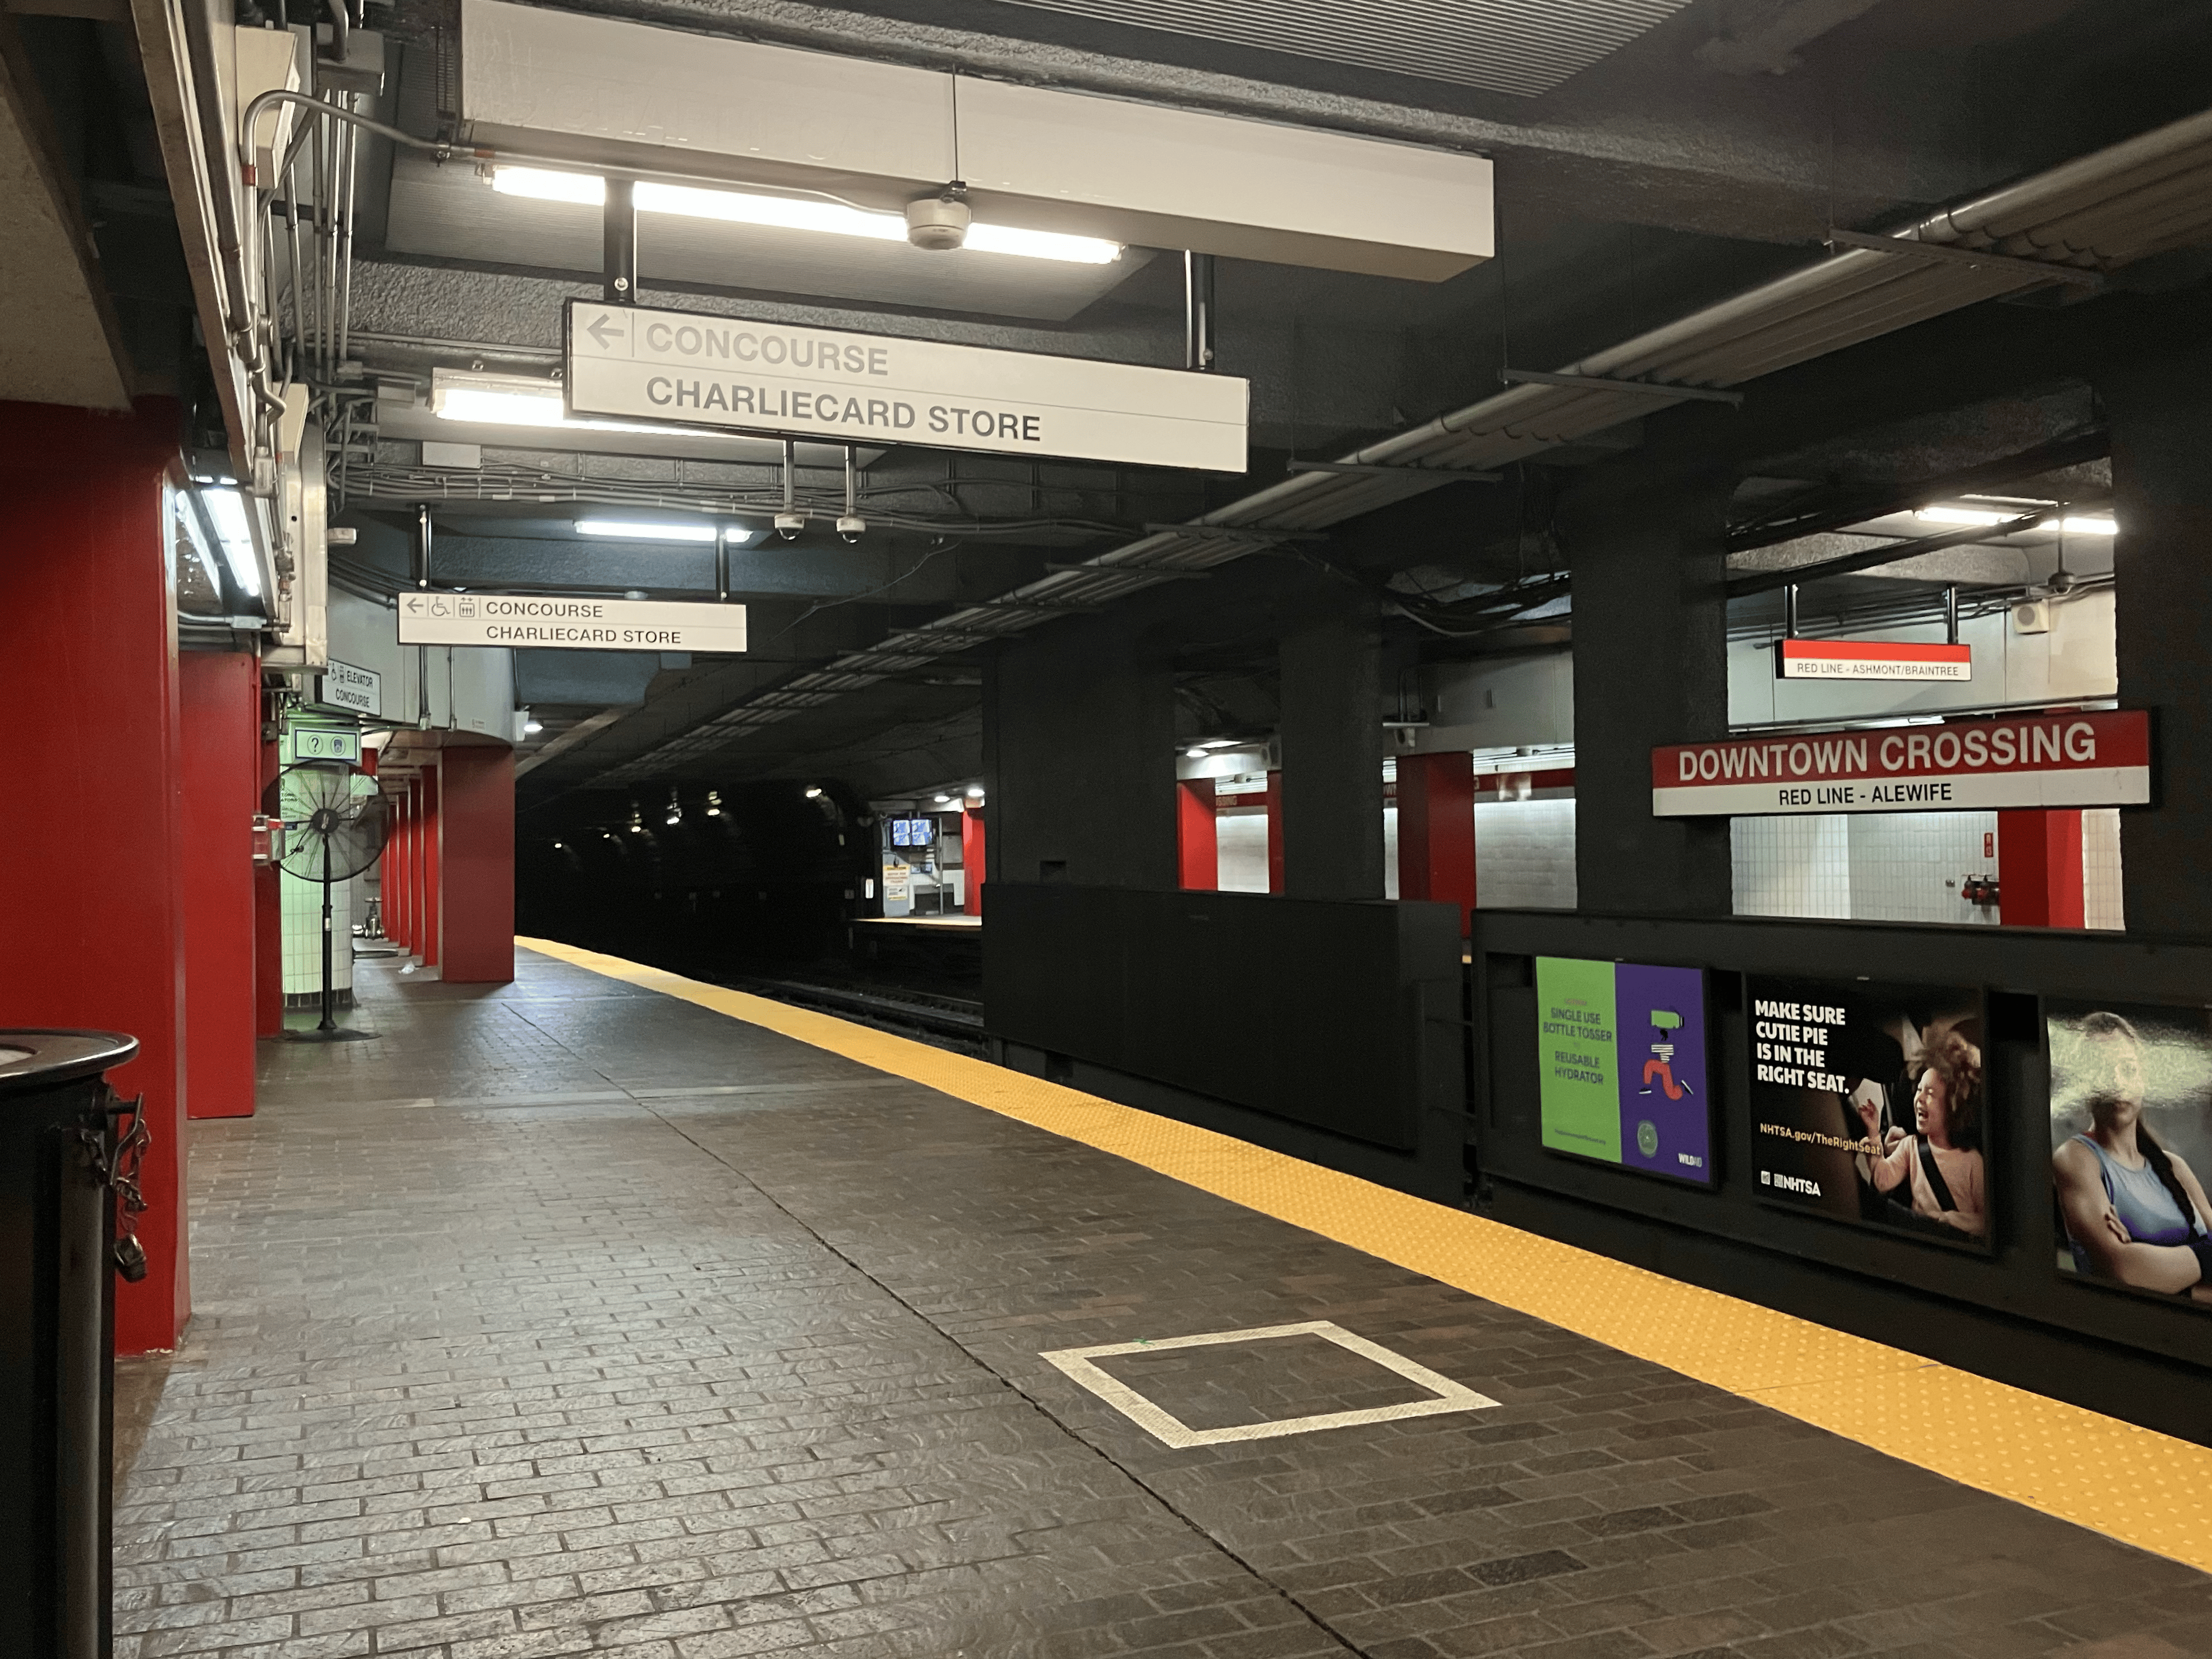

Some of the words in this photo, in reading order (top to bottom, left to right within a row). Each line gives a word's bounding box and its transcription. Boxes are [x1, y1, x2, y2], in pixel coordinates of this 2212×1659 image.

[646, 323, 889, 376] CONCOURSE
[647, 377, 916, 429] CHARLIECARD
[928, 406, 1041, 442] STORE
[486, 602, 603, 618] CONCOURSE
[486, 626, 617, 642] CHARLIECARD
[623, 630, 682, 644] STORE
[347, 670, 373, 689] ELEVATOR
[1797, 663, 1818, 673] RED
[1821, 663, 1843, 673] LINE
[1853, 665, 1959, 676] ASHMONT/BRAINTREE
[336, 688, 369, 708] CONCOURSE
[1679, 738, 1868, 781] DOWNTOWN
[1879, 722, 2096, 772] CROSSING
[1778, 787, 1811, 806] RED
[1817, 786, 1854, 805] LINE
[1871, 782, 1953, 802] ALEWIFE
[1551, 1007, 1582, 1022] SINGLE
[1584, 1012, 1601, 1025] USE
[1755, 999, 1801, 1021] MAKE
[1803, 1004, 1845, 1026] SURE
[1543, 1021, 1575, 1037] BOTTLE
[1577, 1026, 1612, 1042] TOSSER
[1756, 1021, 1800, 1042] CUTIE
[1803, 1027, 1828, 1046] PIE
[1555, 1051, 1600, 1069] REUSABLE
[1757, 1042, 1772, 1060] IS
[1775, 1045, 1792, 1062] IN
[1795, 1047, 1825, 1067] THE
[1555, 1066, 1604, 1085] HYDRATOR
[1758, 1064, 1805, 1086] RIGHT
[1807, 1070, 1850, 1094] SEAT.
[1760, 1123, 1881, 1155] NHTSA.gov/TheRightSeat
[1784, 1175, 1821, 1196] NHTSA
